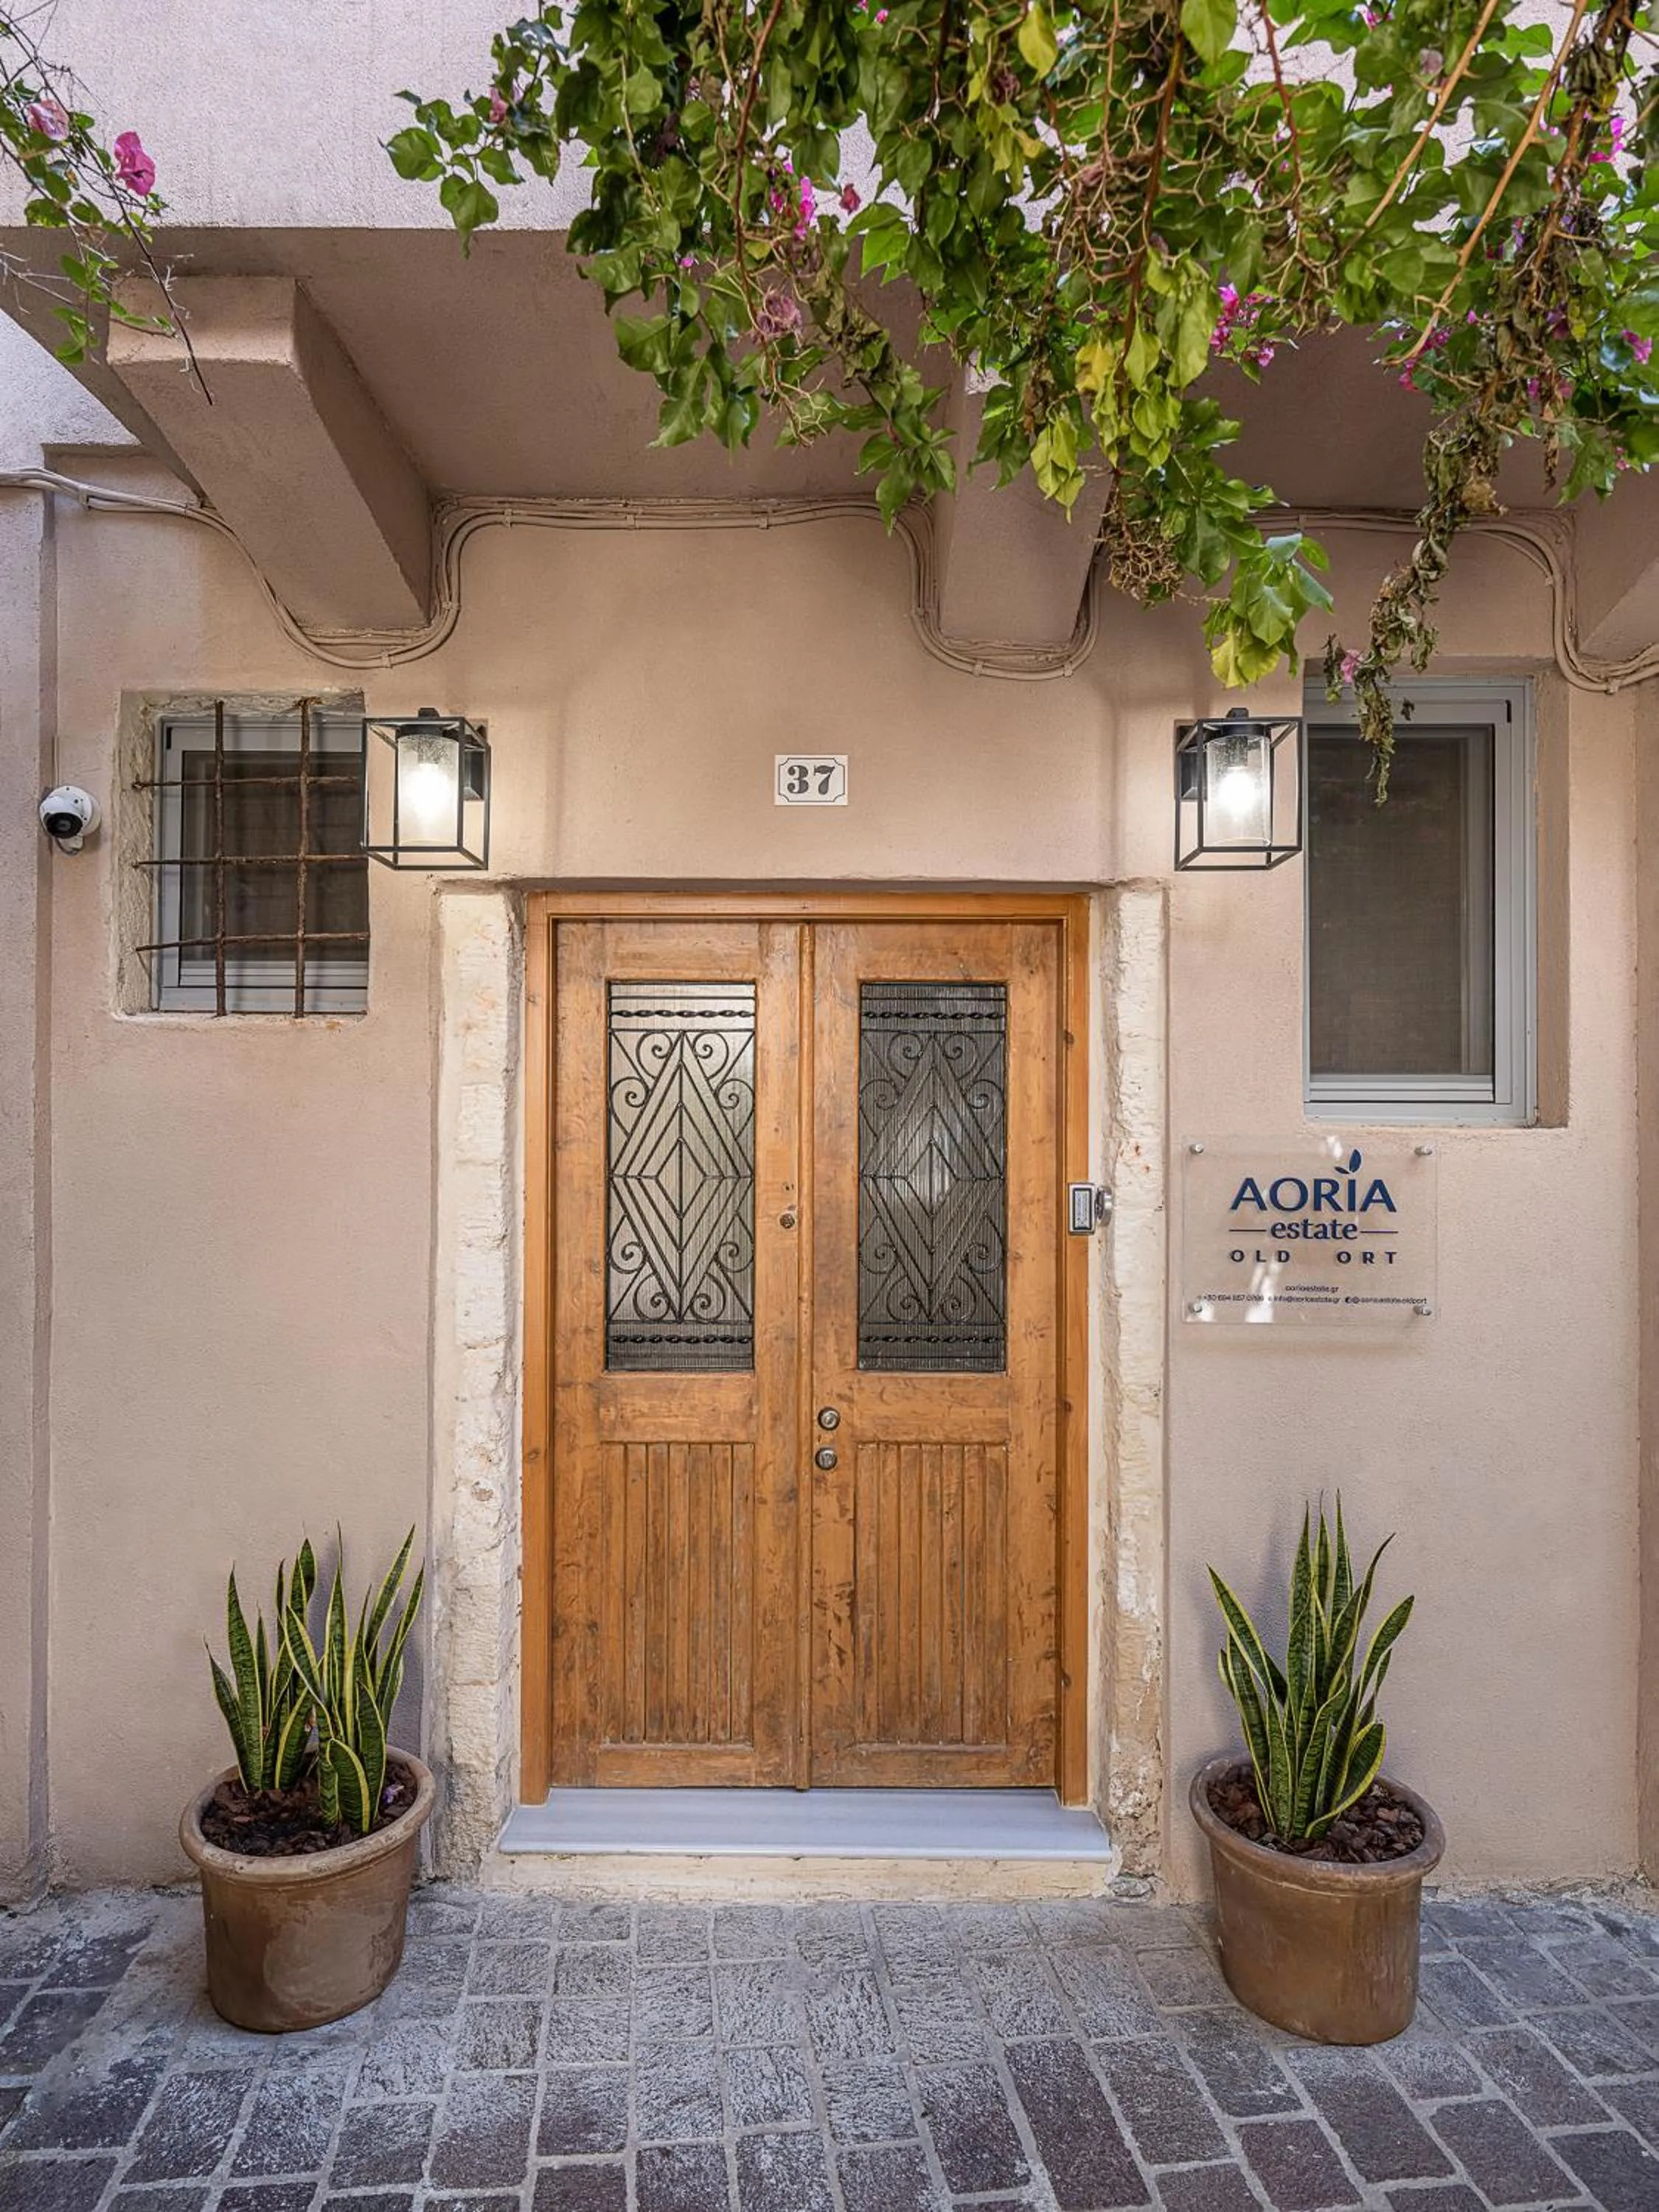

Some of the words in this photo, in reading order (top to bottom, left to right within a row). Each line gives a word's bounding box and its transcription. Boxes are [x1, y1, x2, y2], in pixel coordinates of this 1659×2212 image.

[787, 765, 835, 795] 37
[1230, 1178, 1397, 1212] AORIA
[1270, 1219, 1359, 1240] estate
[1230, 1250, 1291, 1264] OLD
